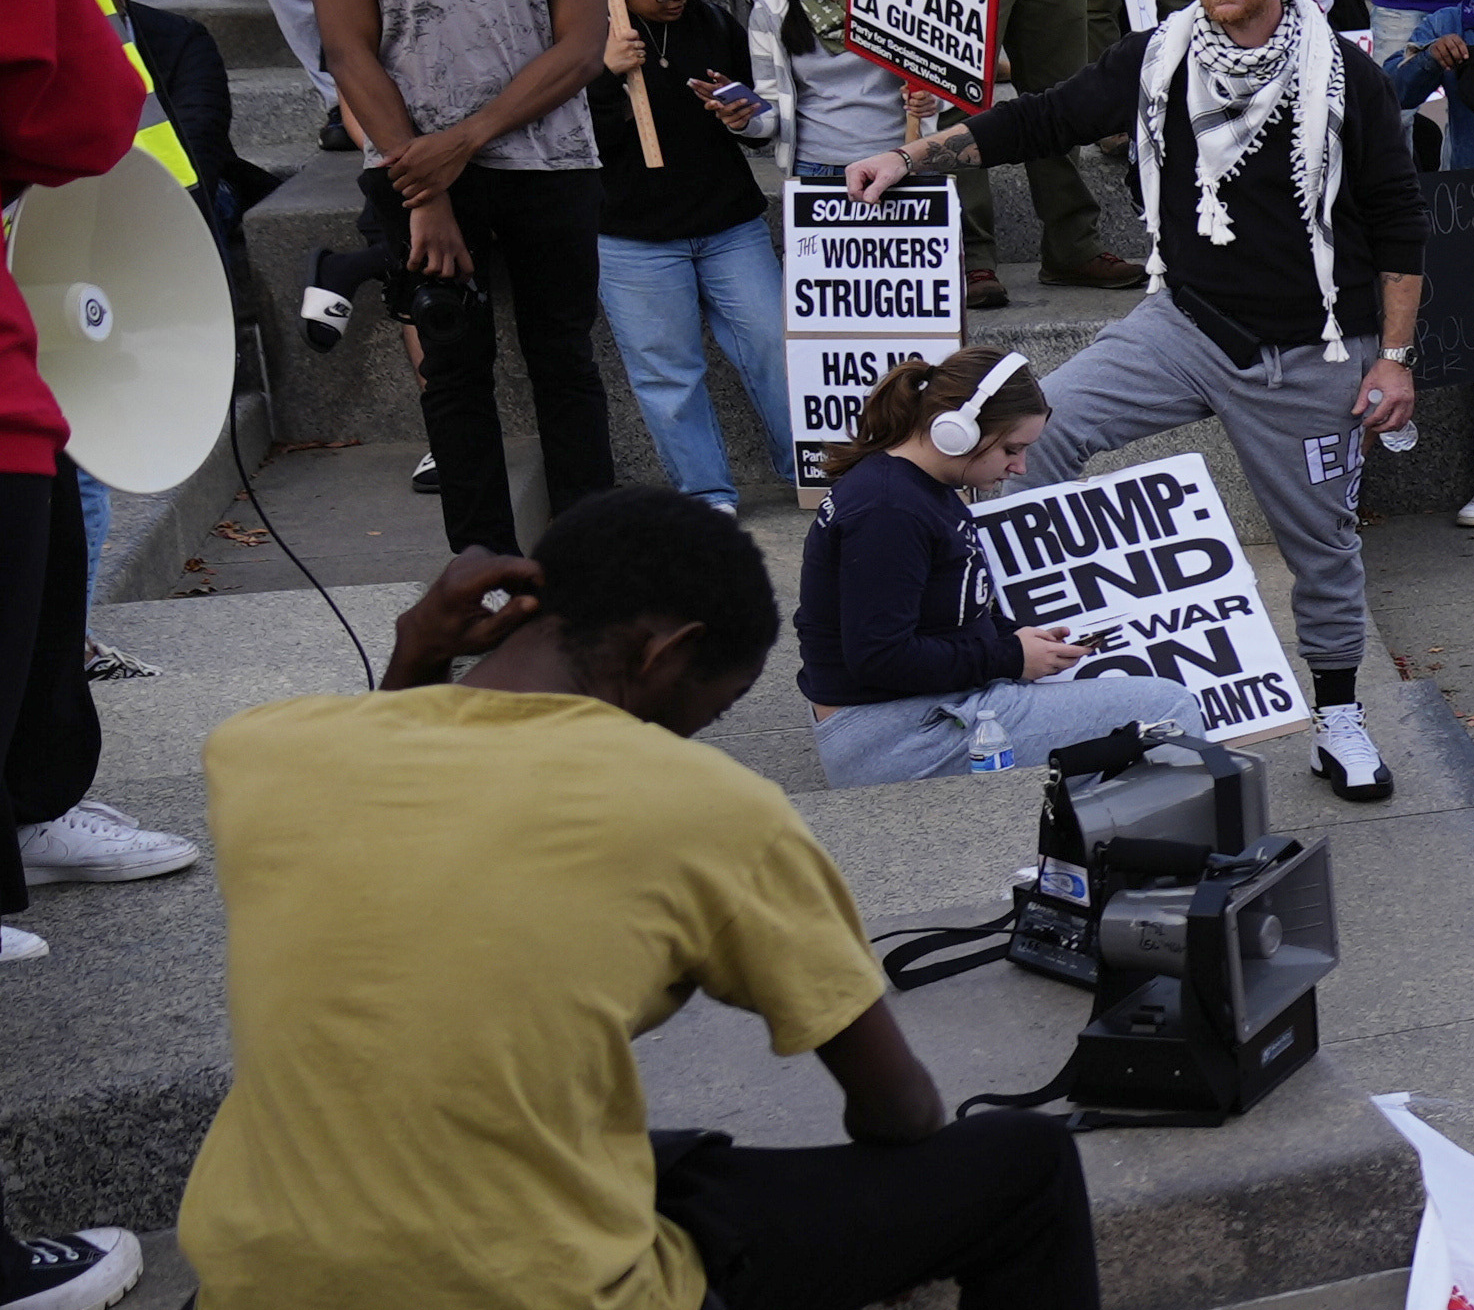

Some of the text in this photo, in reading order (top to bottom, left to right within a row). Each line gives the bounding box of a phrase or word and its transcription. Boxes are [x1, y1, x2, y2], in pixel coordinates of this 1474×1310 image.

[850, 20, 929, 69] Party Socialism
[851, 30, 957, 95] Liberation PSLWeb.org
[886, 7, 983, 72] GUERRA!
[812, 198, 931, 222] SOLIDARITY!
[797, 234, 949, 269] THE WORKERS'
[795, 279, 951, 318] STRUGGLE
[822, 352, 878, 387] HAS
[975, 471, 1211, 577] TRUMP:
[1002, 537, 1235, 628] END
[1129, 595, 1254, 640] WAR
